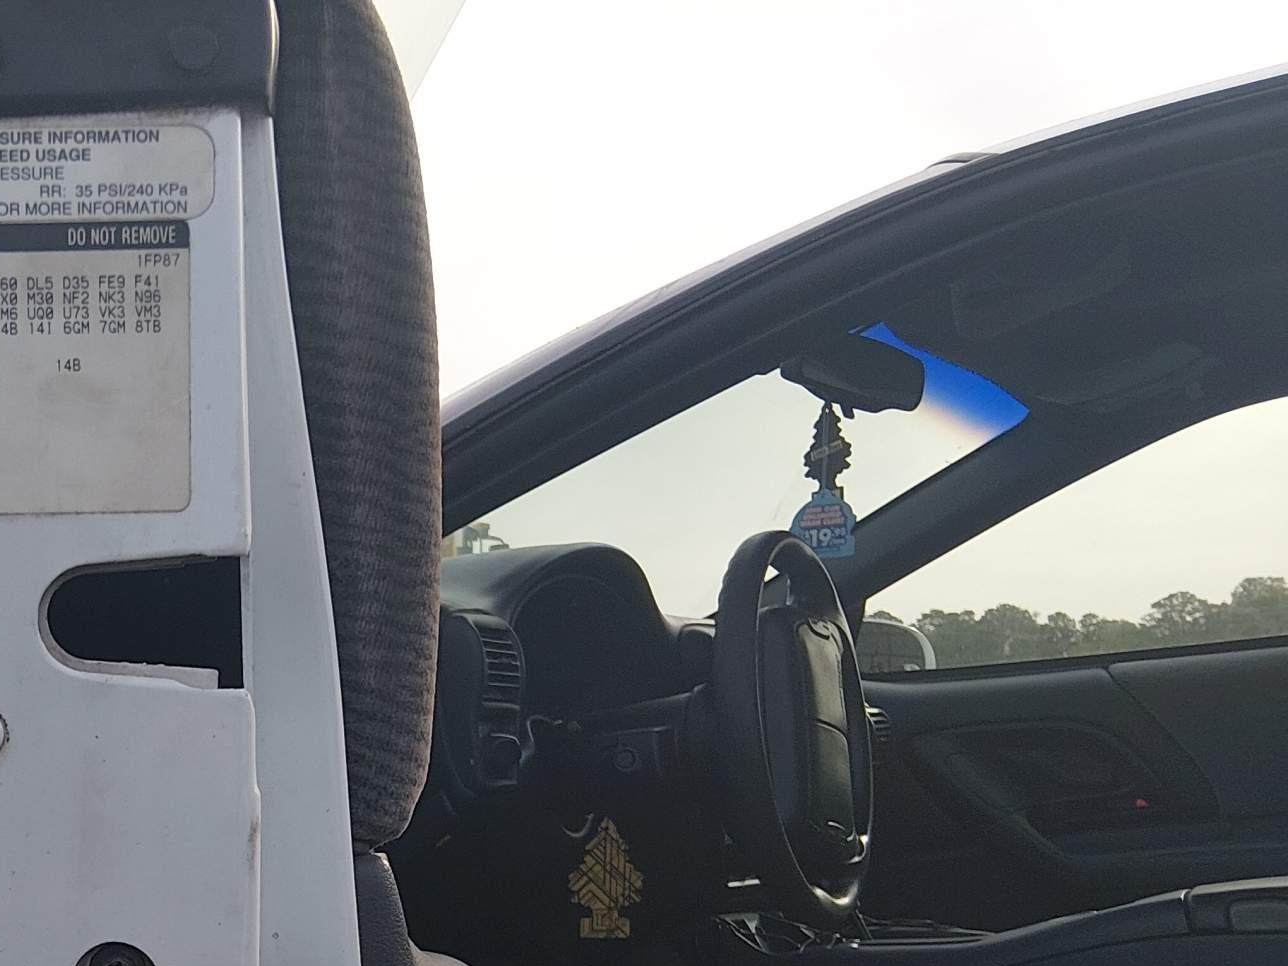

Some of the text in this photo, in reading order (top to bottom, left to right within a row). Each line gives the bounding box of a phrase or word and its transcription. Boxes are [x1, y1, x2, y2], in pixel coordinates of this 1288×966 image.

[48, 129, 159, 144] INFORMATION
[35, 148, 90, 162] USAGE
[40, 182, 188, 198] RR: 35 PSI/240 KPa
[25, 202, 71, 216] MORE
[77, 200, 187, 215] INFORMATION
[68, 225, 175, 246] DO NOT REMOVE
[138, 253, 180, 267] 1FP87
[26, 276, 53, 291] DL5
[62, 275, 89, 290] D35
[98, 275, 125, 289] FE9
[134, 274, 158, 288] F41
[57, 358, 81, 372] 14B
